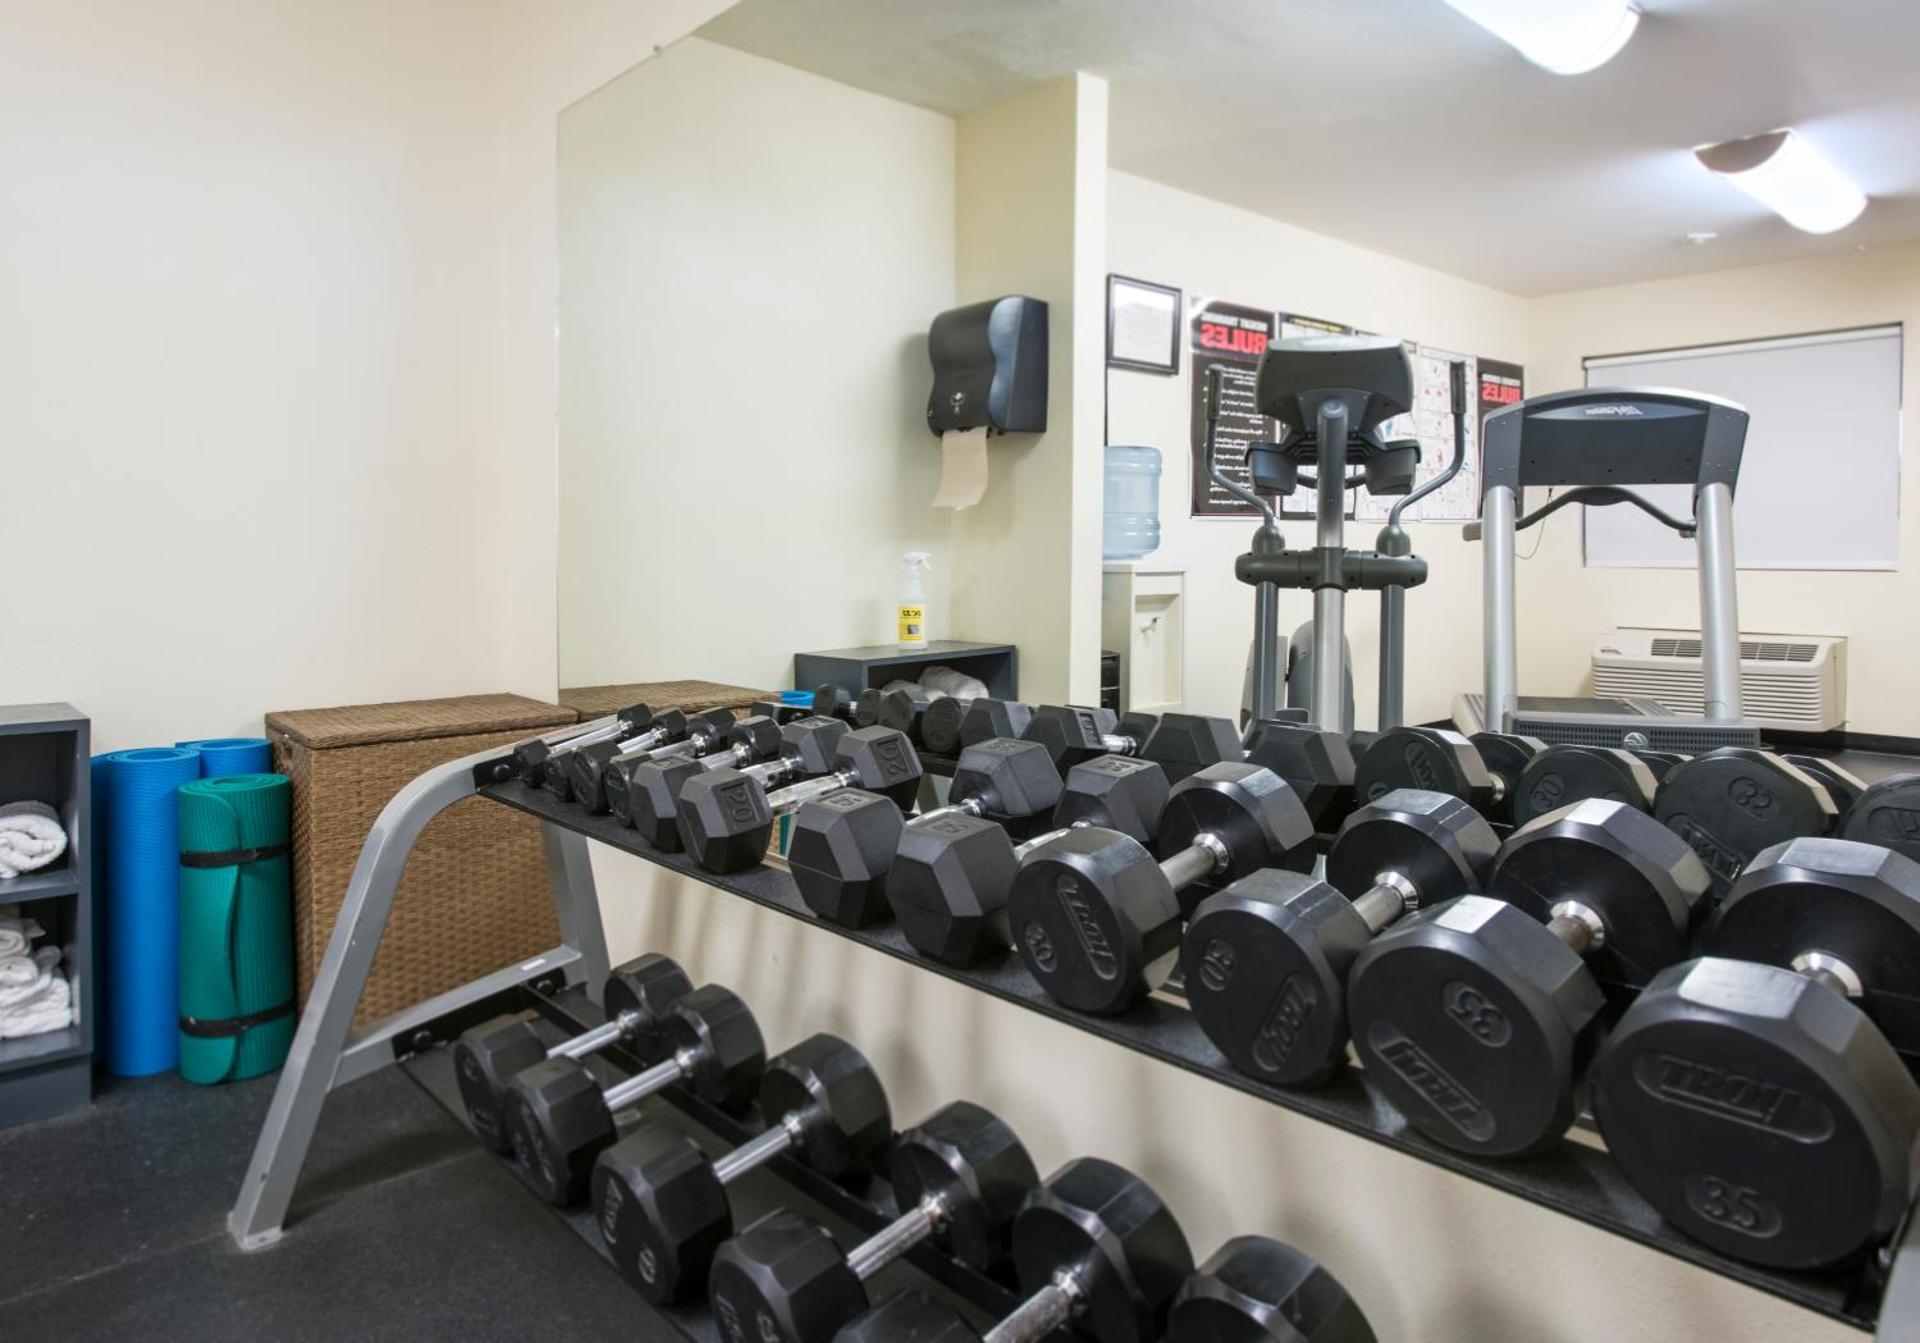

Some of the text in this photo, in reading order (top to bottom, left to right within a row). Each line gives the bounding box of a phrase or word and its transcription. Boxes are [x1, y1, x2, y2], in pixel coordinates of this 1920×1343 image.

[730, 789, 752, 822] 20
[1449, 985, 1504, 1042] 35
[1702, 1174, 1762, 1231] 35
